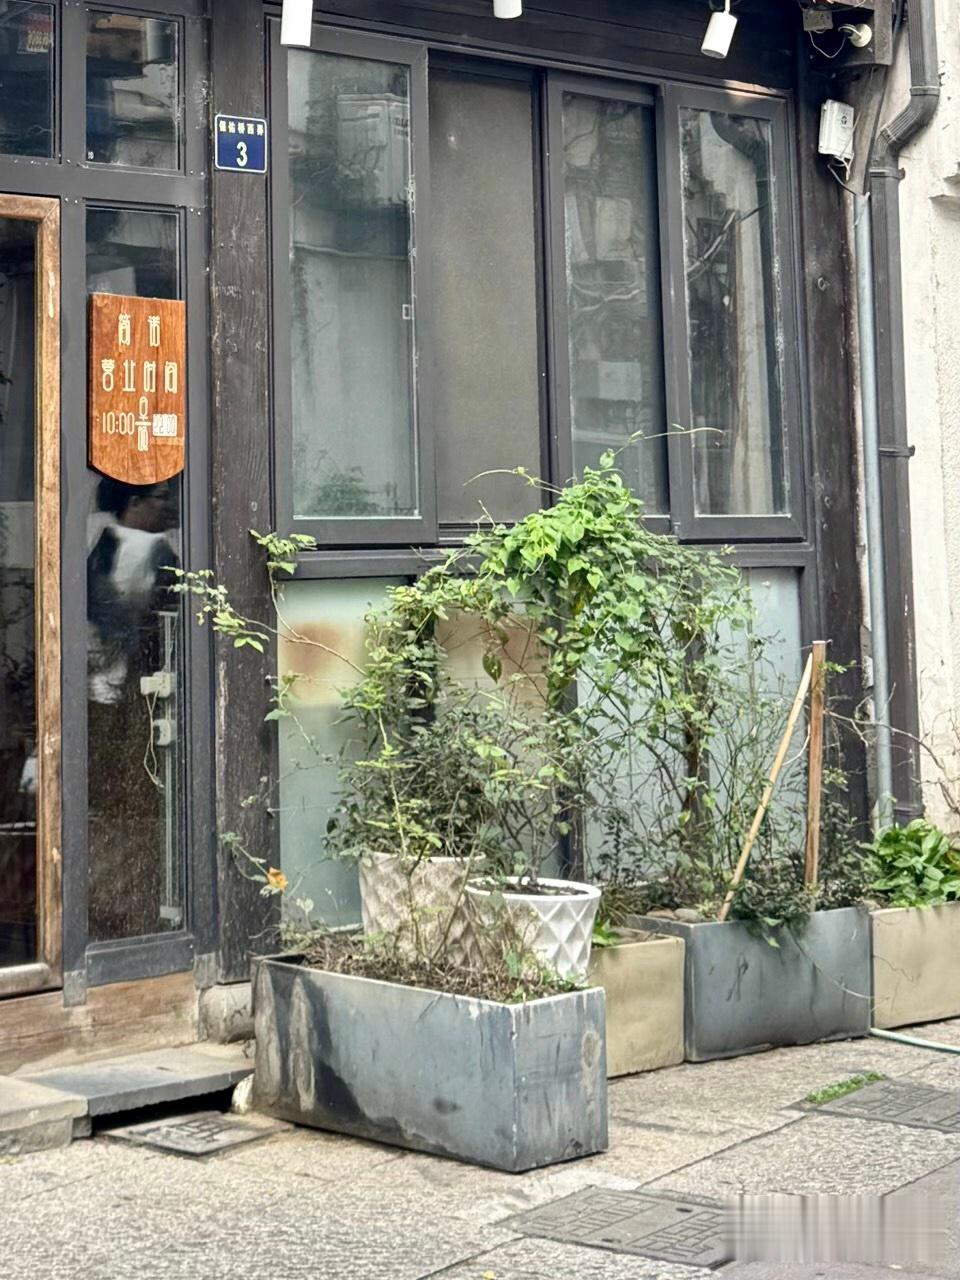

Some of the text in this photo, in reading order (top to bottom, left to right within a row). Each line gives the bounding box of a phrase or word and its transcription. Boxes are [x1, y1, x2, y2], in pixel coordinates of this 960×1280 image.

[236, 141, 248, 167] 3
[101, 358, 178, 394] 营业时间
[102, 412, 135, 435] 10:00
